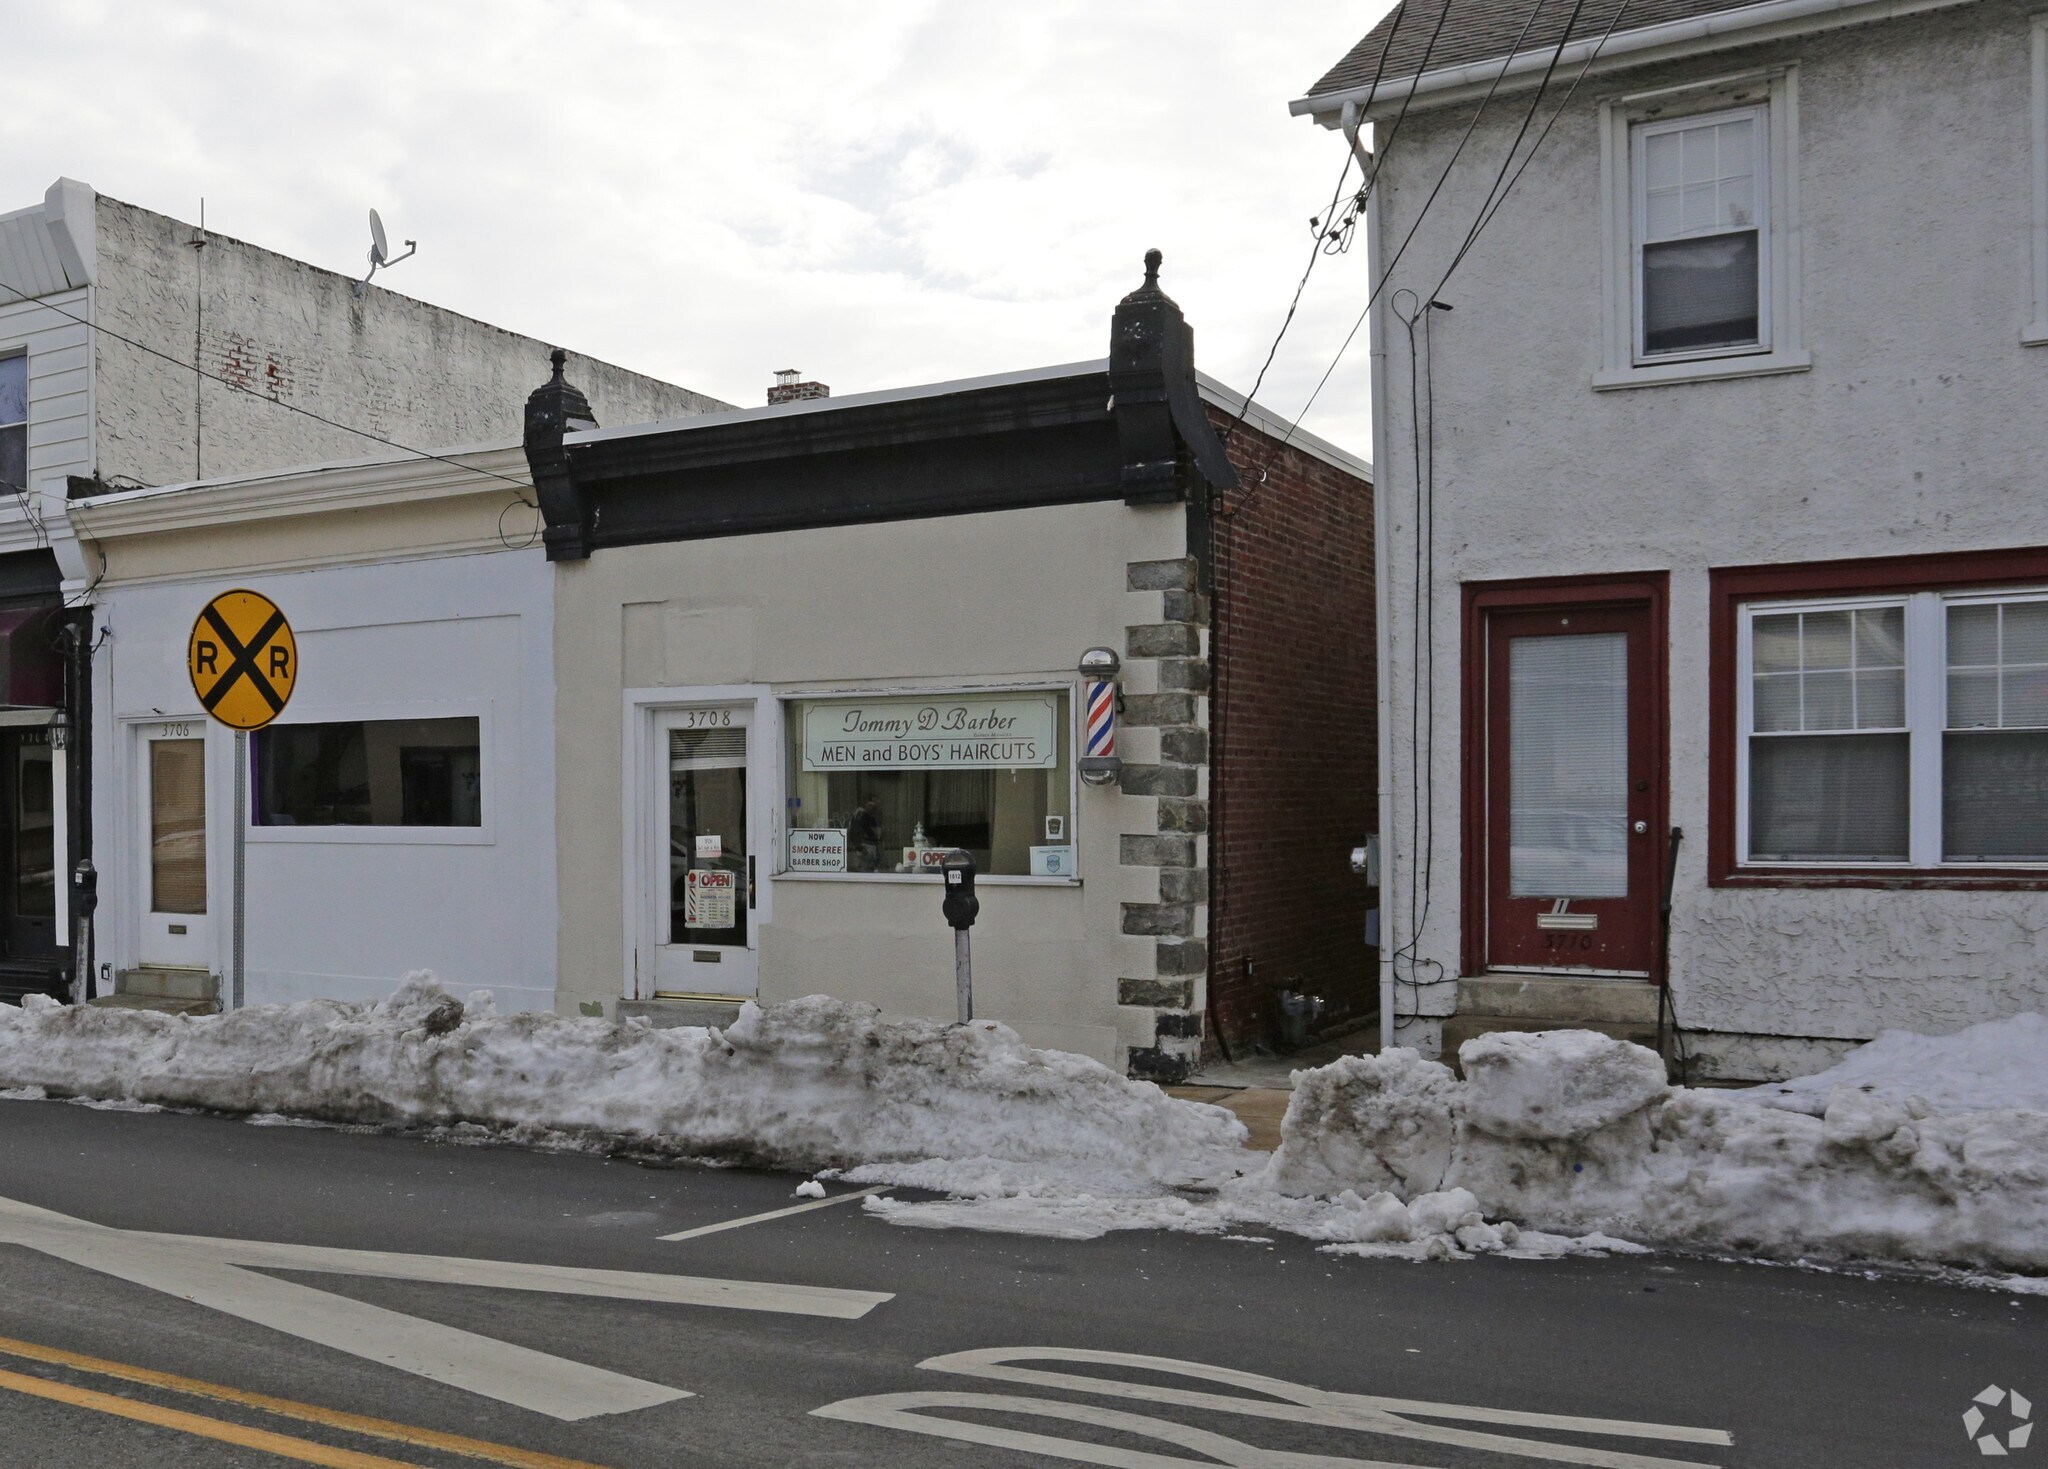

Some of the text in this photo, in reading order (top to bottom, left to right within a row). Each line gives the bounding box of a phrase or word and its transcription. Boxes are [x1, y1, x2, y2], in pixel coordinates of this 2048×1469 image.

[687, 710, 731, 728] 3708
[842, 707, 1017, 739] Tommy D Barber
[162, 723, 190, 737] 3706
[821, 742, 1036, 762] MEN and BOYS' HAIRCUTS
[808, 833, 825, 841] NOW
[791, 845, 842, 854] SMOKE-FREE
[792, 858, 841, 867] BARBER SHOP
[922, 851, 946, 865] OPE
[701, 873, 730, 887] OPEN
